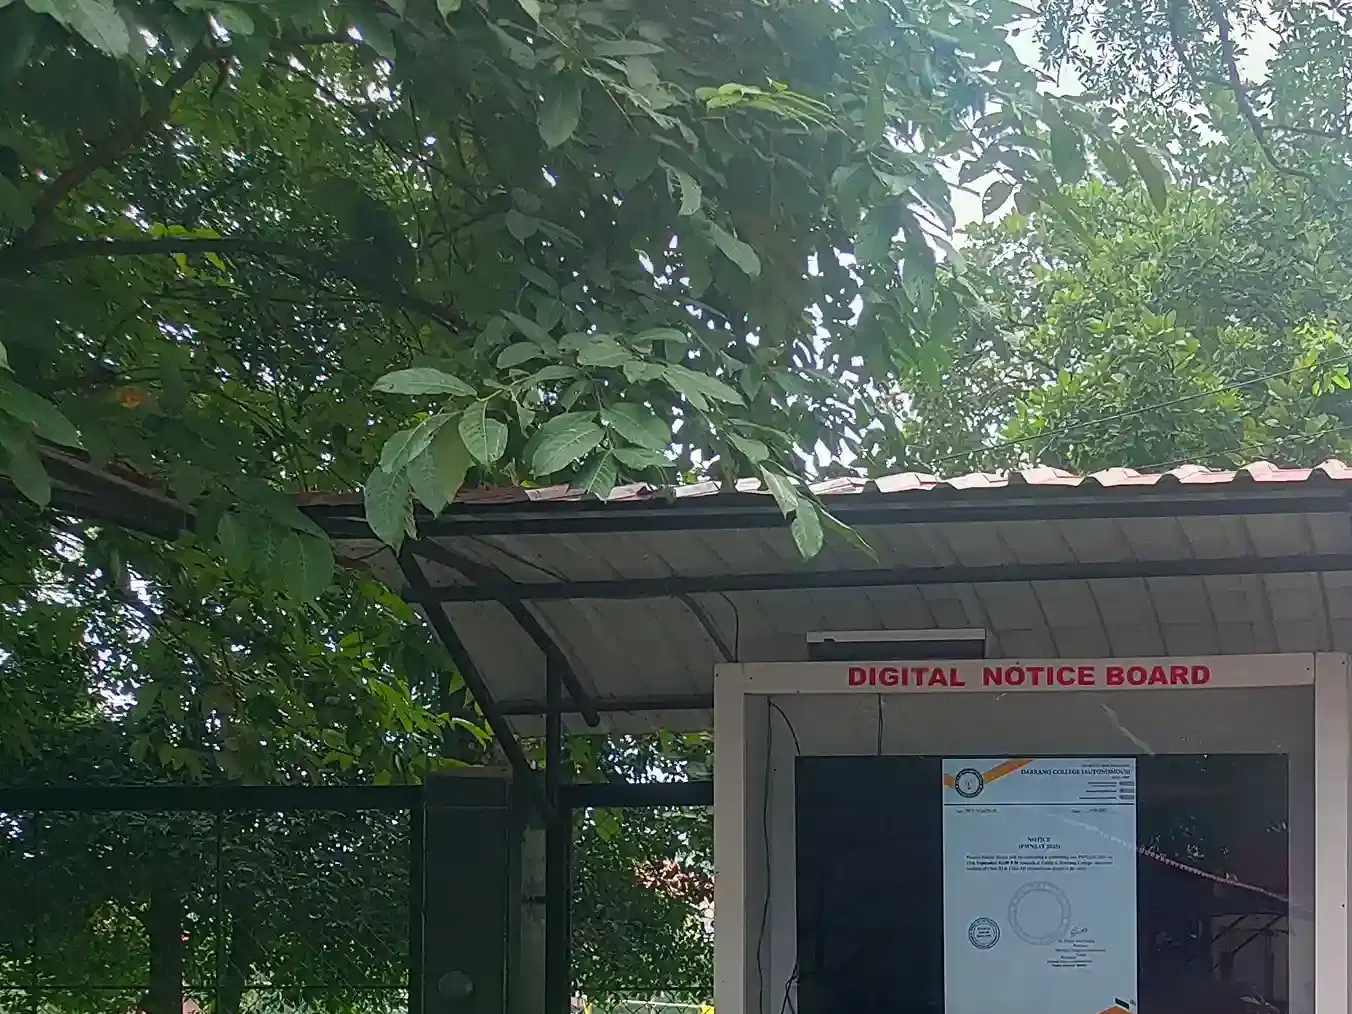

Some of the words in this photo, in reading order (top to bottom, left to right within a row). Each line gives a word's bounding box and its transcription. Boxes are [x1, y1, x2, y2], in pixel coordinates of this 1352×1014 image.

[848, 666, 966, 687] DIGITAL
[982, 664, 1096, 687] NOTICE
[1105, 664, 1211, 686] BOARD
